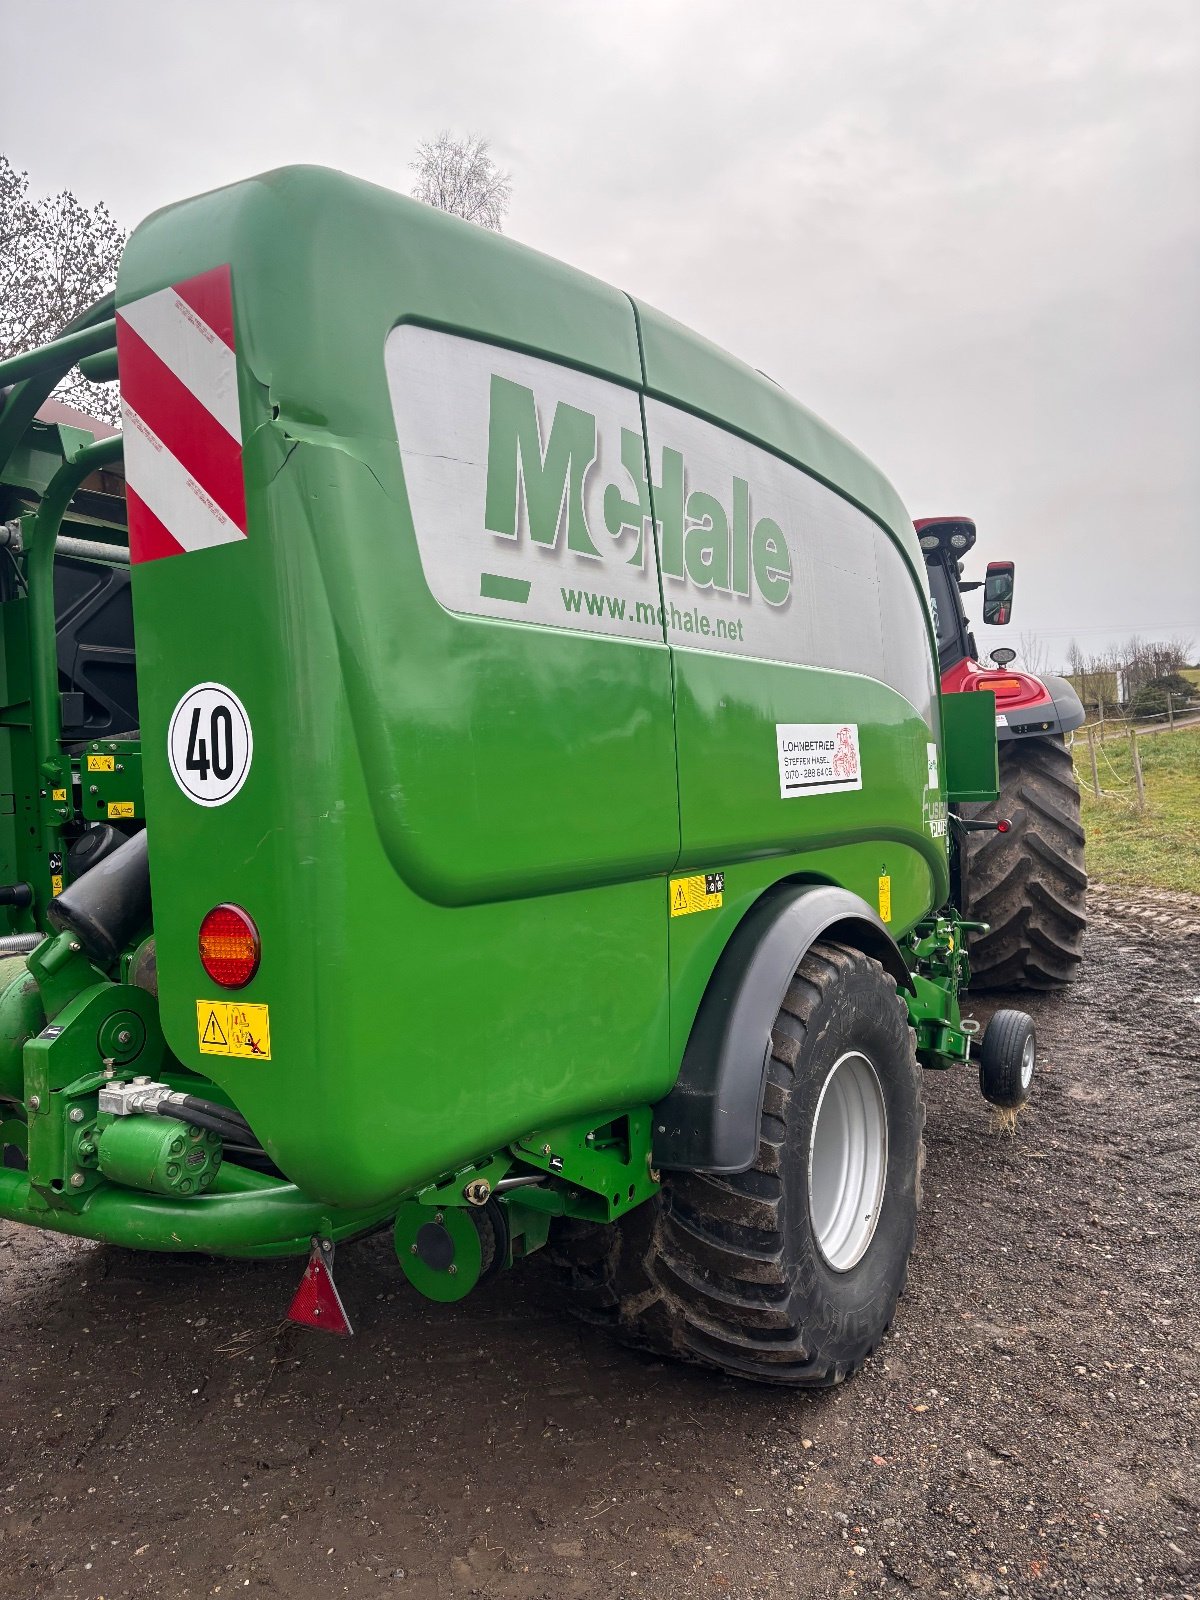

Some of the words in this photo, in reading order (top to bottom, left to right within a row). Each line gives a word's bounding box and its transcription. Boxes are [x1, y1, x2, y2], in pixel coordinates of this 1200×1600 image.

[485, 373, 791, 605] McHale
[560, 587, 744, 641] www.mchale.net
[186, 705, 234, 780] 40
[782, 740, 835, 752] LOHNBETRIEB
[784, 757, 811, 767] STEFFEN
